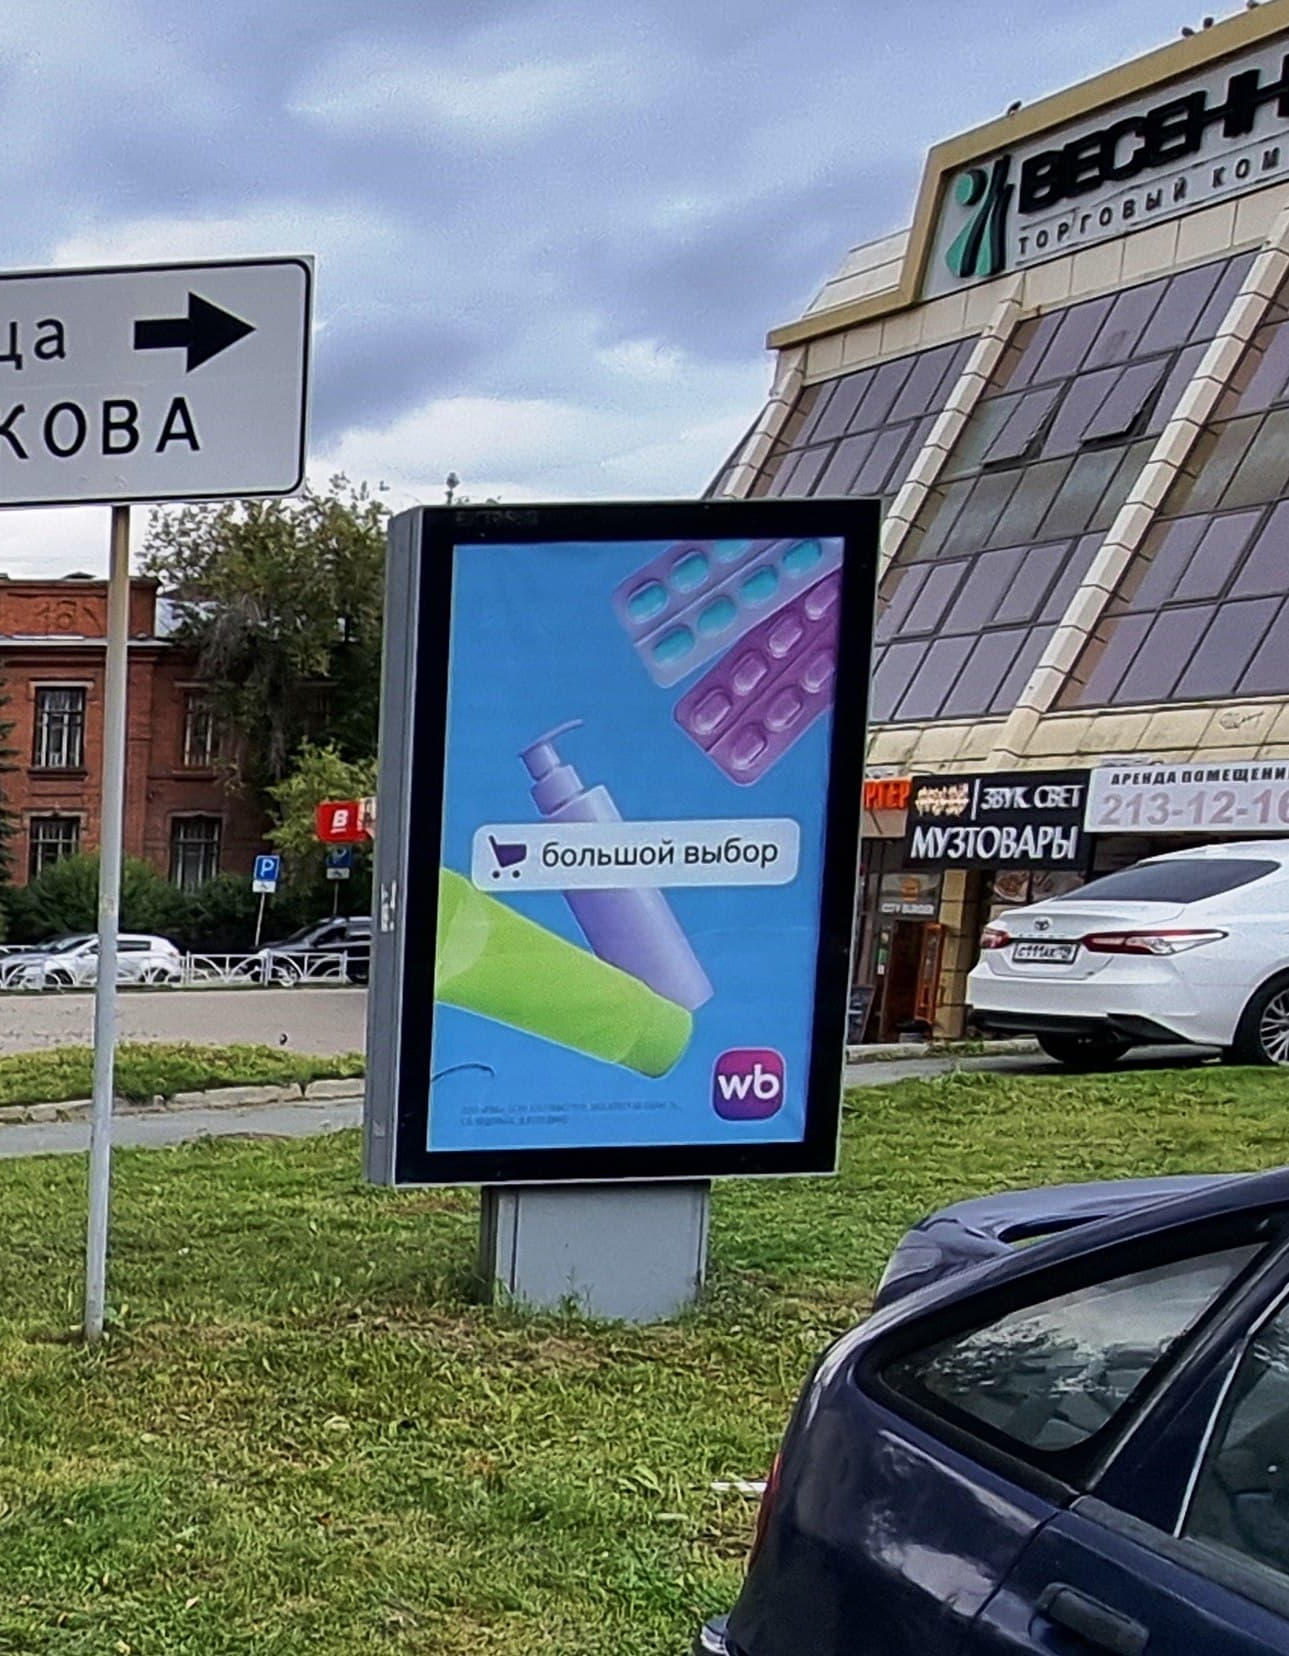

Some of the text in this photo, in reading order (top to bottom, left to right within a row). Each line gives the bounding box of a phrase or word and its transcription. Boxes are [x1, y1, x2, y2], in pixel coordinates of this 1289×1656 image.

[1018, 147, 1281, 255] ТОРГОВЫЙ КОМ
[1110, 766, 1289, 785] АРЕНДА ПОМЕЩЕНИ
[981, 786, 1032, 810] ЗВУК
[1034, 784, 1085, 809] СВЕТ
[542, 837, 778, 869] большой выбор
[910, 824, 1079, 860] МУЗТОВАРЫ
[717, 1063, 780, 1100] wb
